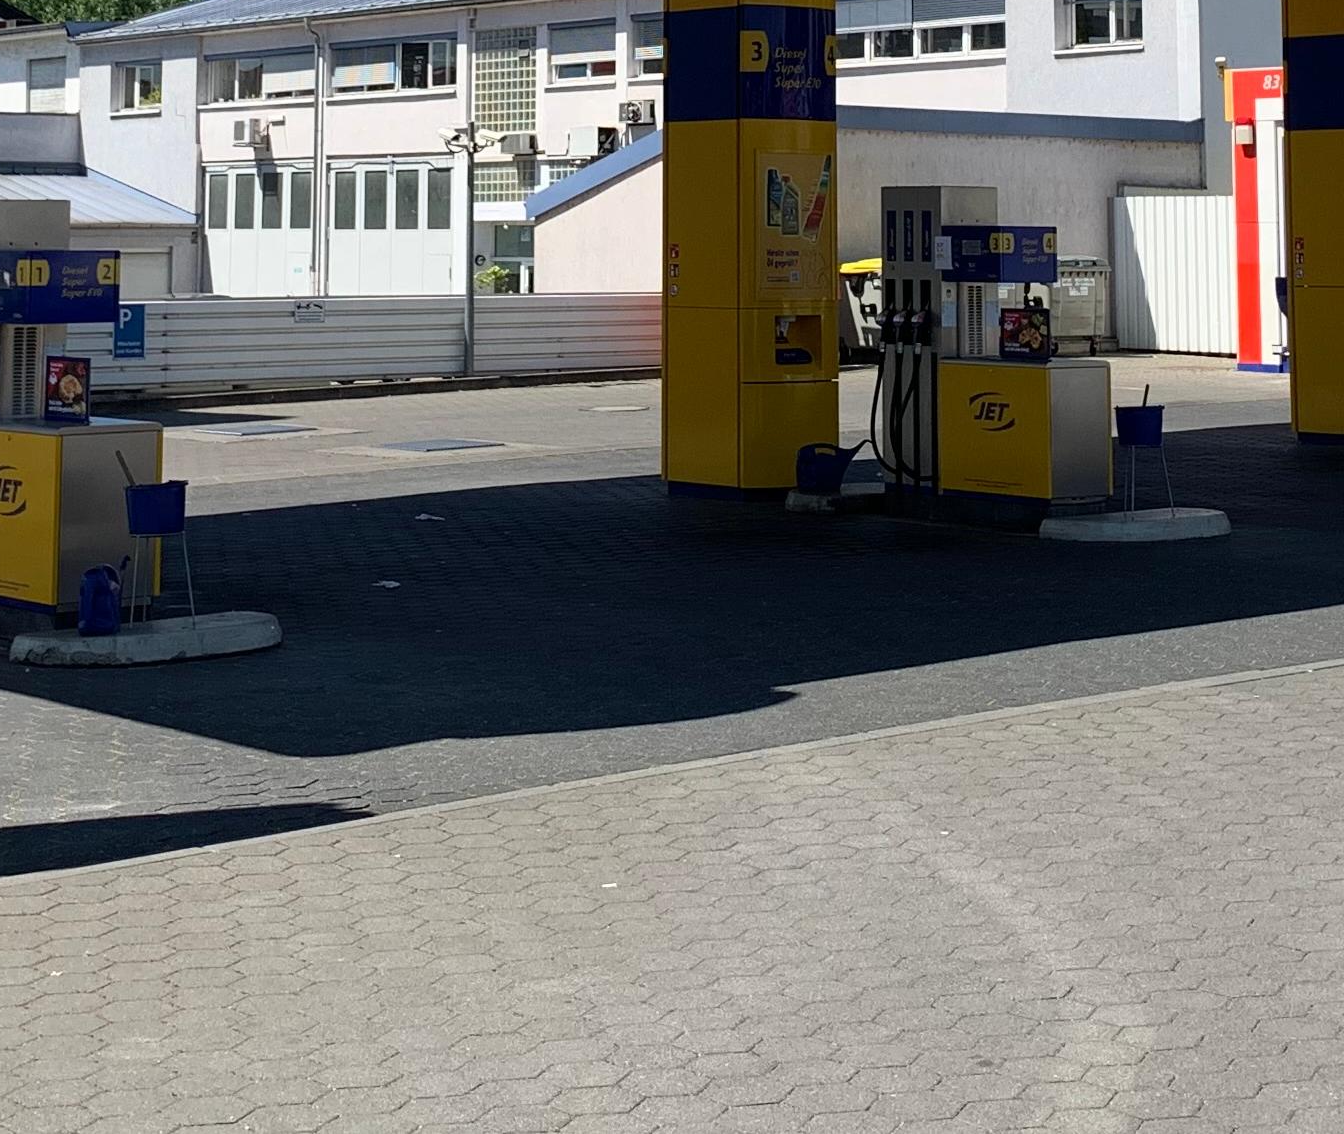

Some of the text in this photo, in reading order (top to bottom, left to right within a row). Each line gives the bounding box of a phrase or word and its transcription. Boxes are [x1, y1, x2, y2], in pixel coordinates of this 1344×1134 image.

[752, 41, 762, 62] 3
[992, 237, 1052, 250] 3 3 4
[35, 267, 42, 283] 1
[103, 264, 112, 280] 2
[120, 308, 132, 329] P
[974, 401, 1010, 422] JET
